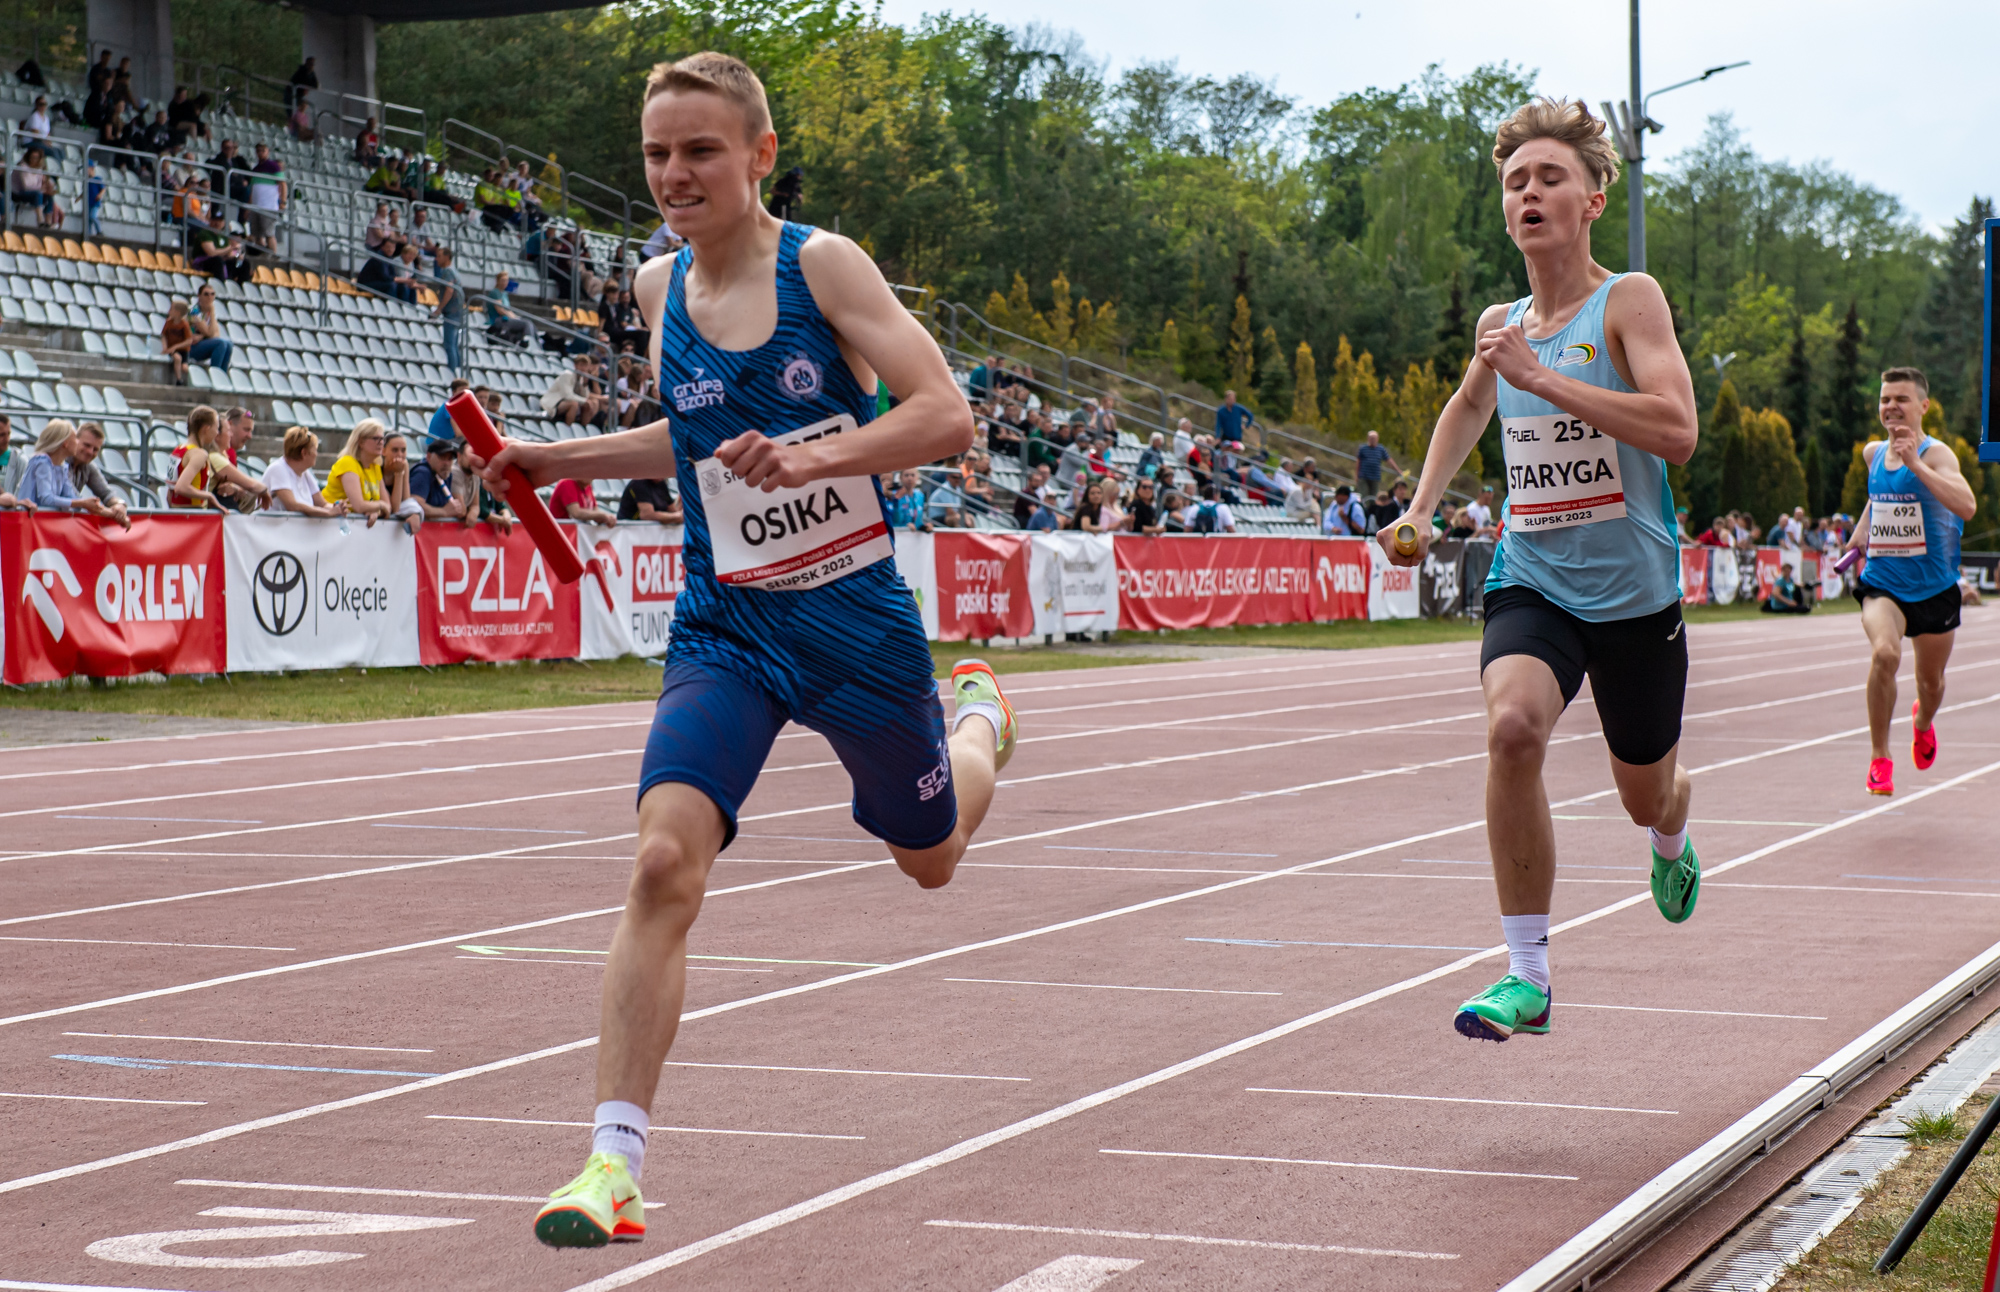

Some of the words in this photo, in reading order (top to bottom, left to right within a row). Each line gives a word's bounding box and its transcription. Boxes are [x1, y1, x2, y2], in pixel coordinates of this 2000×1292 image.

[1553, 419, 1602, 443] 251
[1510, 457, 1615, 490] STARYGA
[740, 486, 849, 546] OSIKA
[1524, 515, 1563, 527] SŁUPSK
[1565, 511, 1593, 522] 2023
[1552, 503, 1571, 511] Polski
[1893, 506, 1917, 517] 692
[732, 571, 752, 582] PZLA
[753, 560, 802, 580] Mistrzostwa
[802, 550, 826, 564] Polski
[827, 547, 834, 555] w
[834, 530, 874, 552] Sztafetach
[765, 568, 820, 590] SŁUPSK
[820, 554, 855, 576] 2023
[95, 562, 208, 623] ORLEN
[437, 545, 554, 613] PZLA
[1117, 568, 1165, 599] POLSKI
[1165, 568, 1218, 603] ZWIĄZEK
[1219, 567, 1262, 596] LEKKIEJ
[1333, 562, 1367, 594] ORLEN
[324, 575, 388, 620] Okęcie
